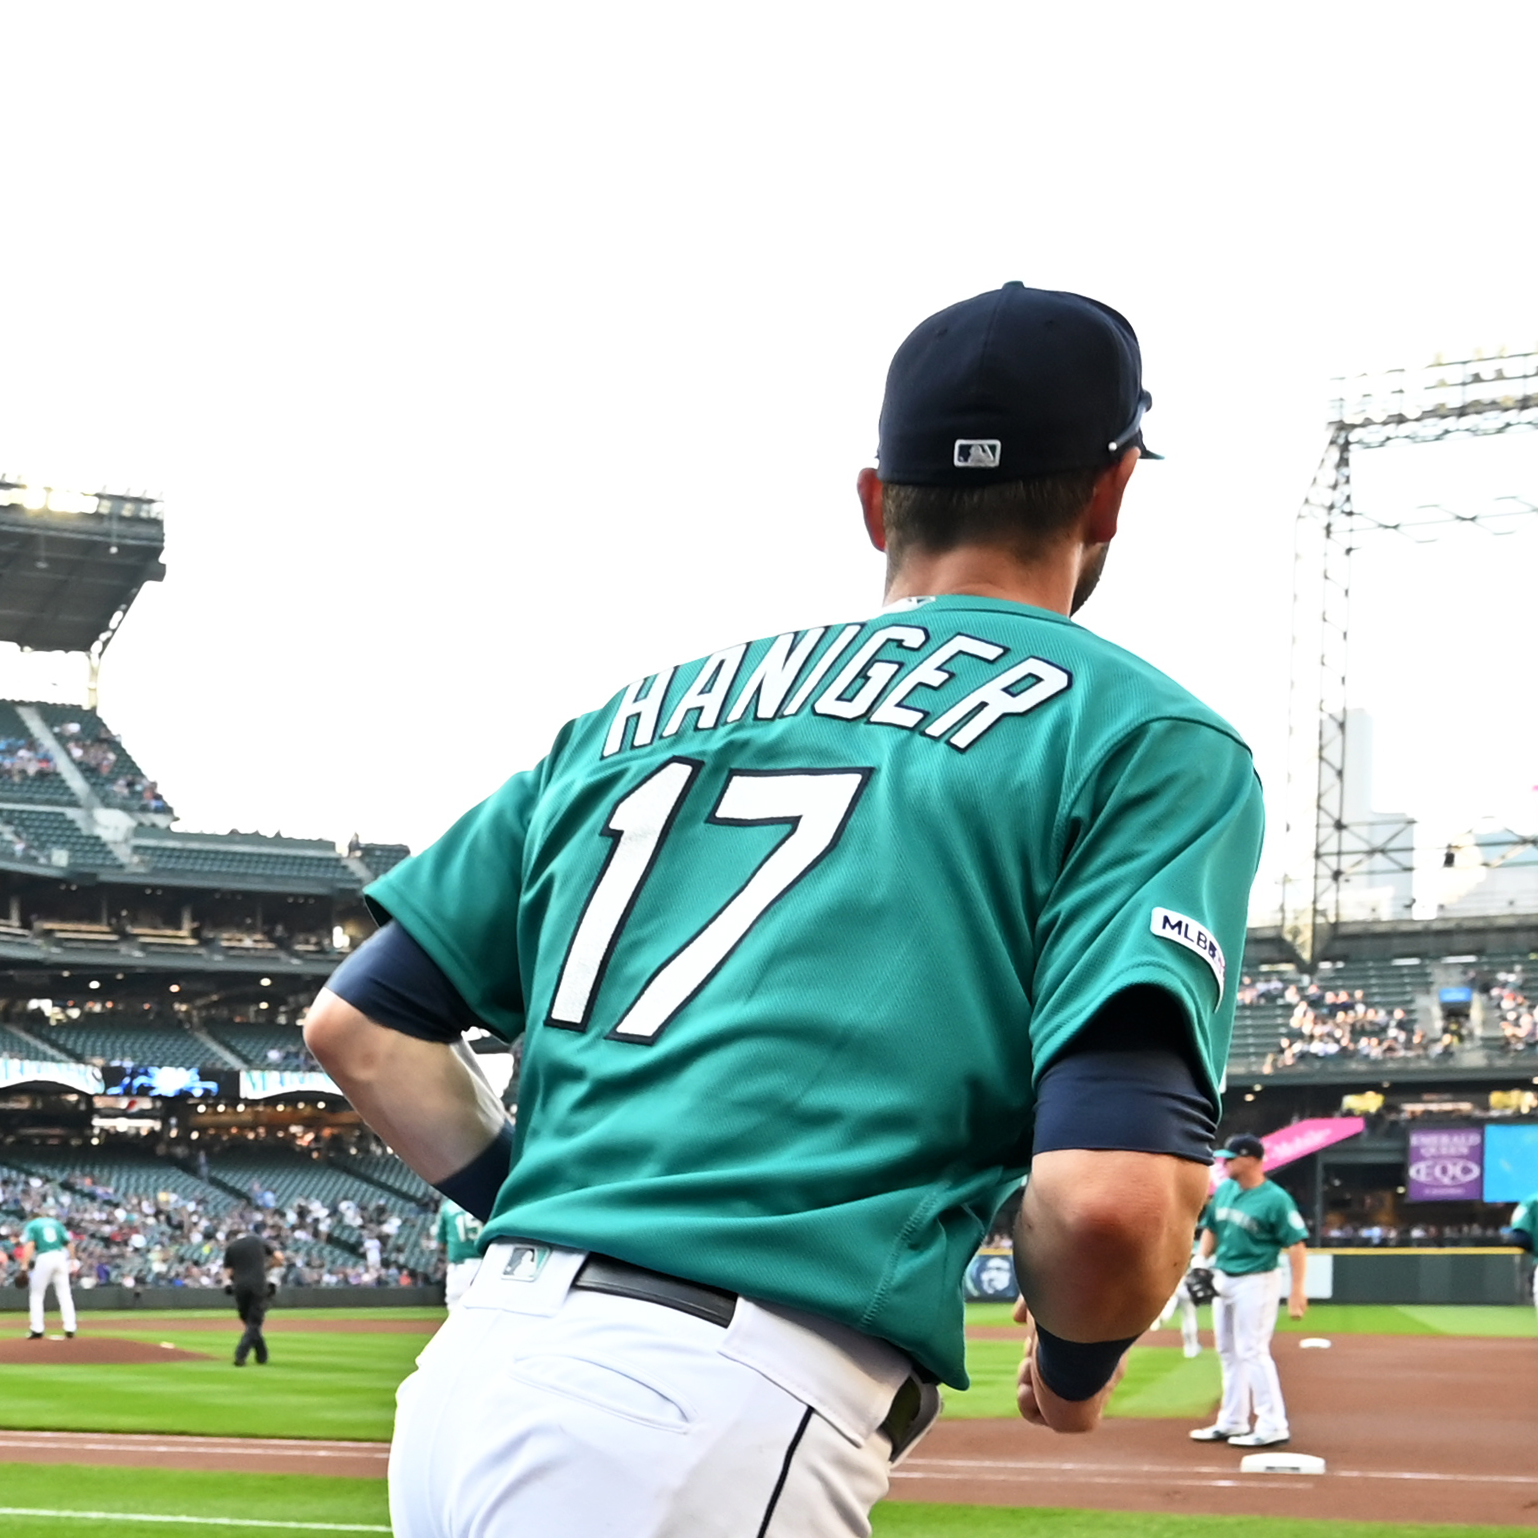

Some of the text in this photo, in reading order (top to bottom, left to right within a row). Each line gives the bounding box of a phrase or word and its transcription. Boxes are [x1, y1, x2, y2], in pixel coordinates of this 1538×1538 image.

[601, 620, 1074, 757] HANIGER
[541, 755, 875, 1046] 17
[1162, 914, 1208, 951] MLB
